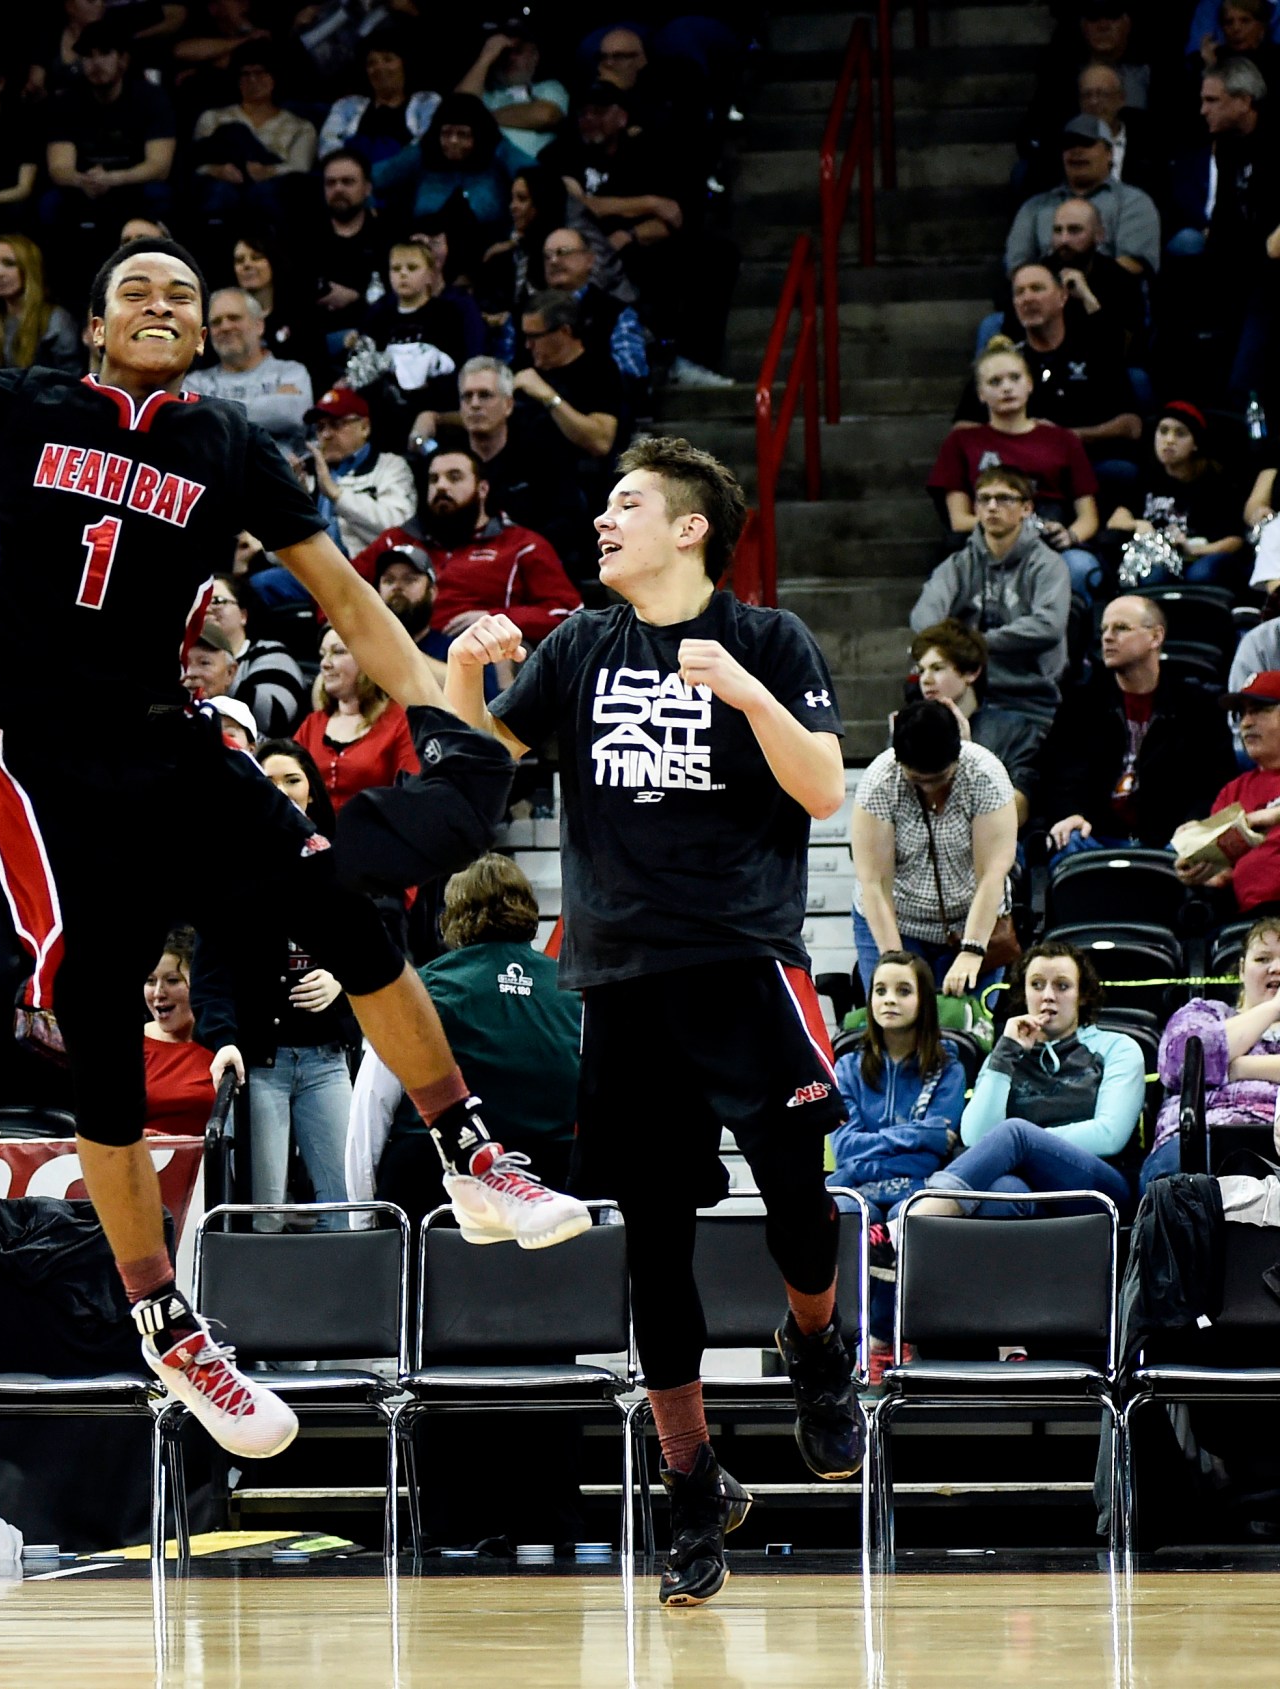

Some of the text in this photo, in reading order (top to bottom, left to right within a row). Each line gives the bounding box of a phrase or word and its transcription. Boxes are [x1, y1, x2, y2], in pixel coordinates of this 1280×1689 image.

[33, 443, 206, 528] NEAH BAY
[76, 515, 123, 610] 1
[595, 668, 609, 695] I
[592, 694, 712, 729] DO
[591, 722, 711, 760] ALL
[790, 1081, 829, 1105] NB
